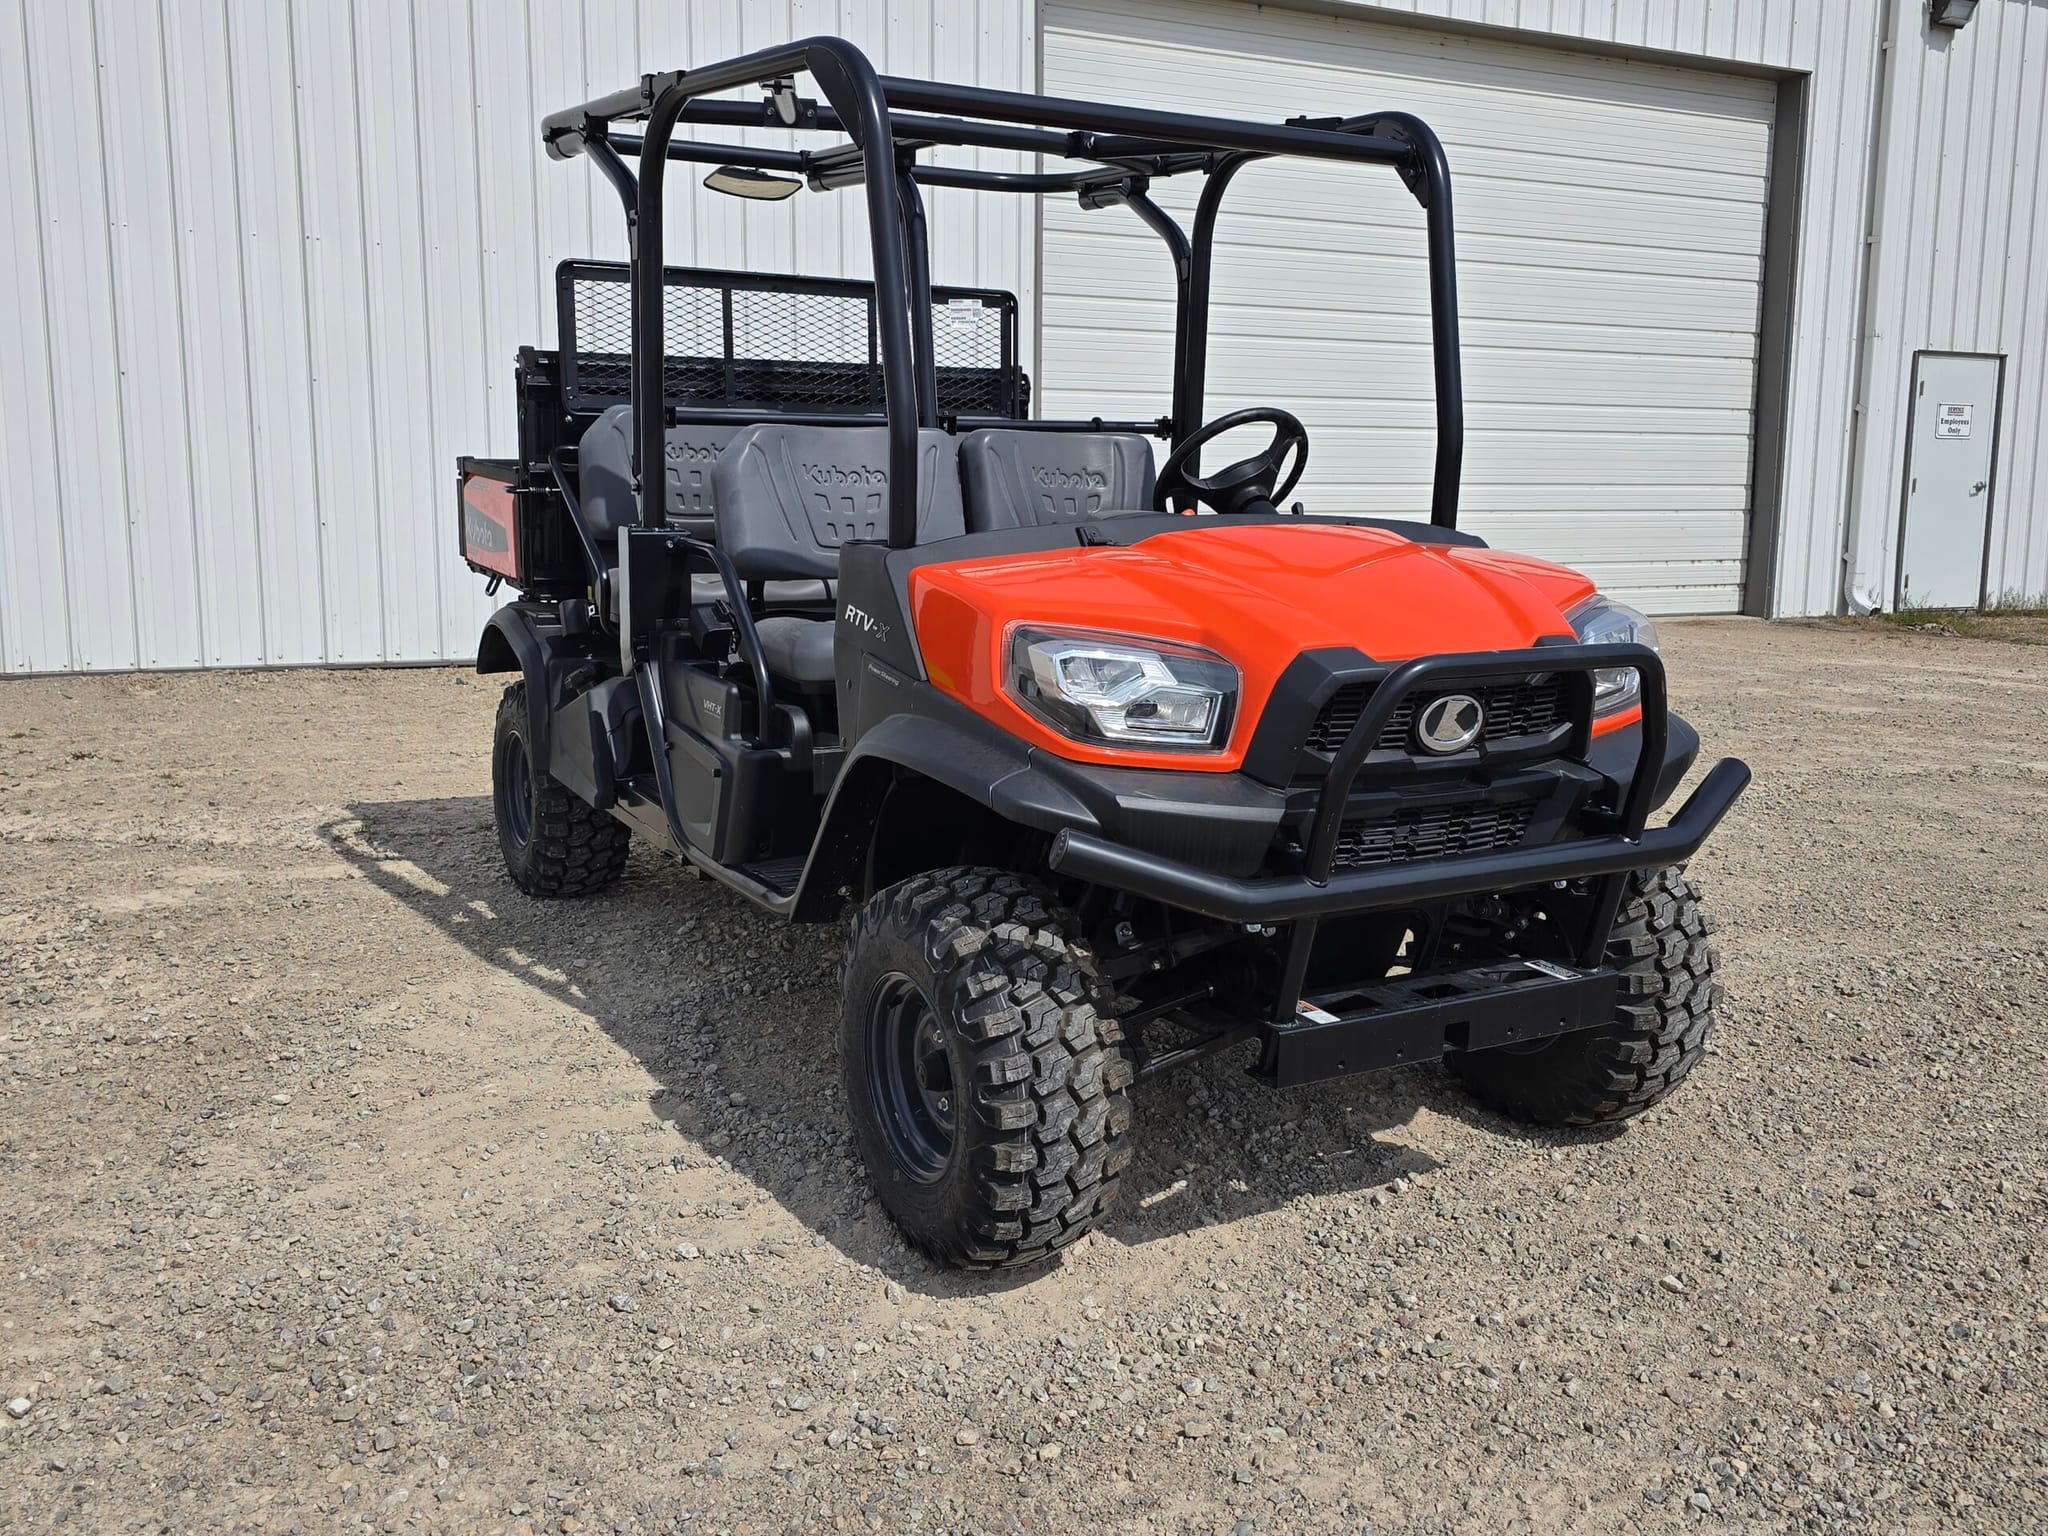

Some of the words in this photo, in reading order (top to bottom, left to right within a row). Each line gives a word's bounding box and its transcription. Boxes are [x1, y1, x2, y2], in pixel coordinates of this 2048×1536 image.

[802, 463, 888, 487] Kubota
[1032, 466, 1106, 489] Kubota
[844, 604, 890, 642] RTV-X
